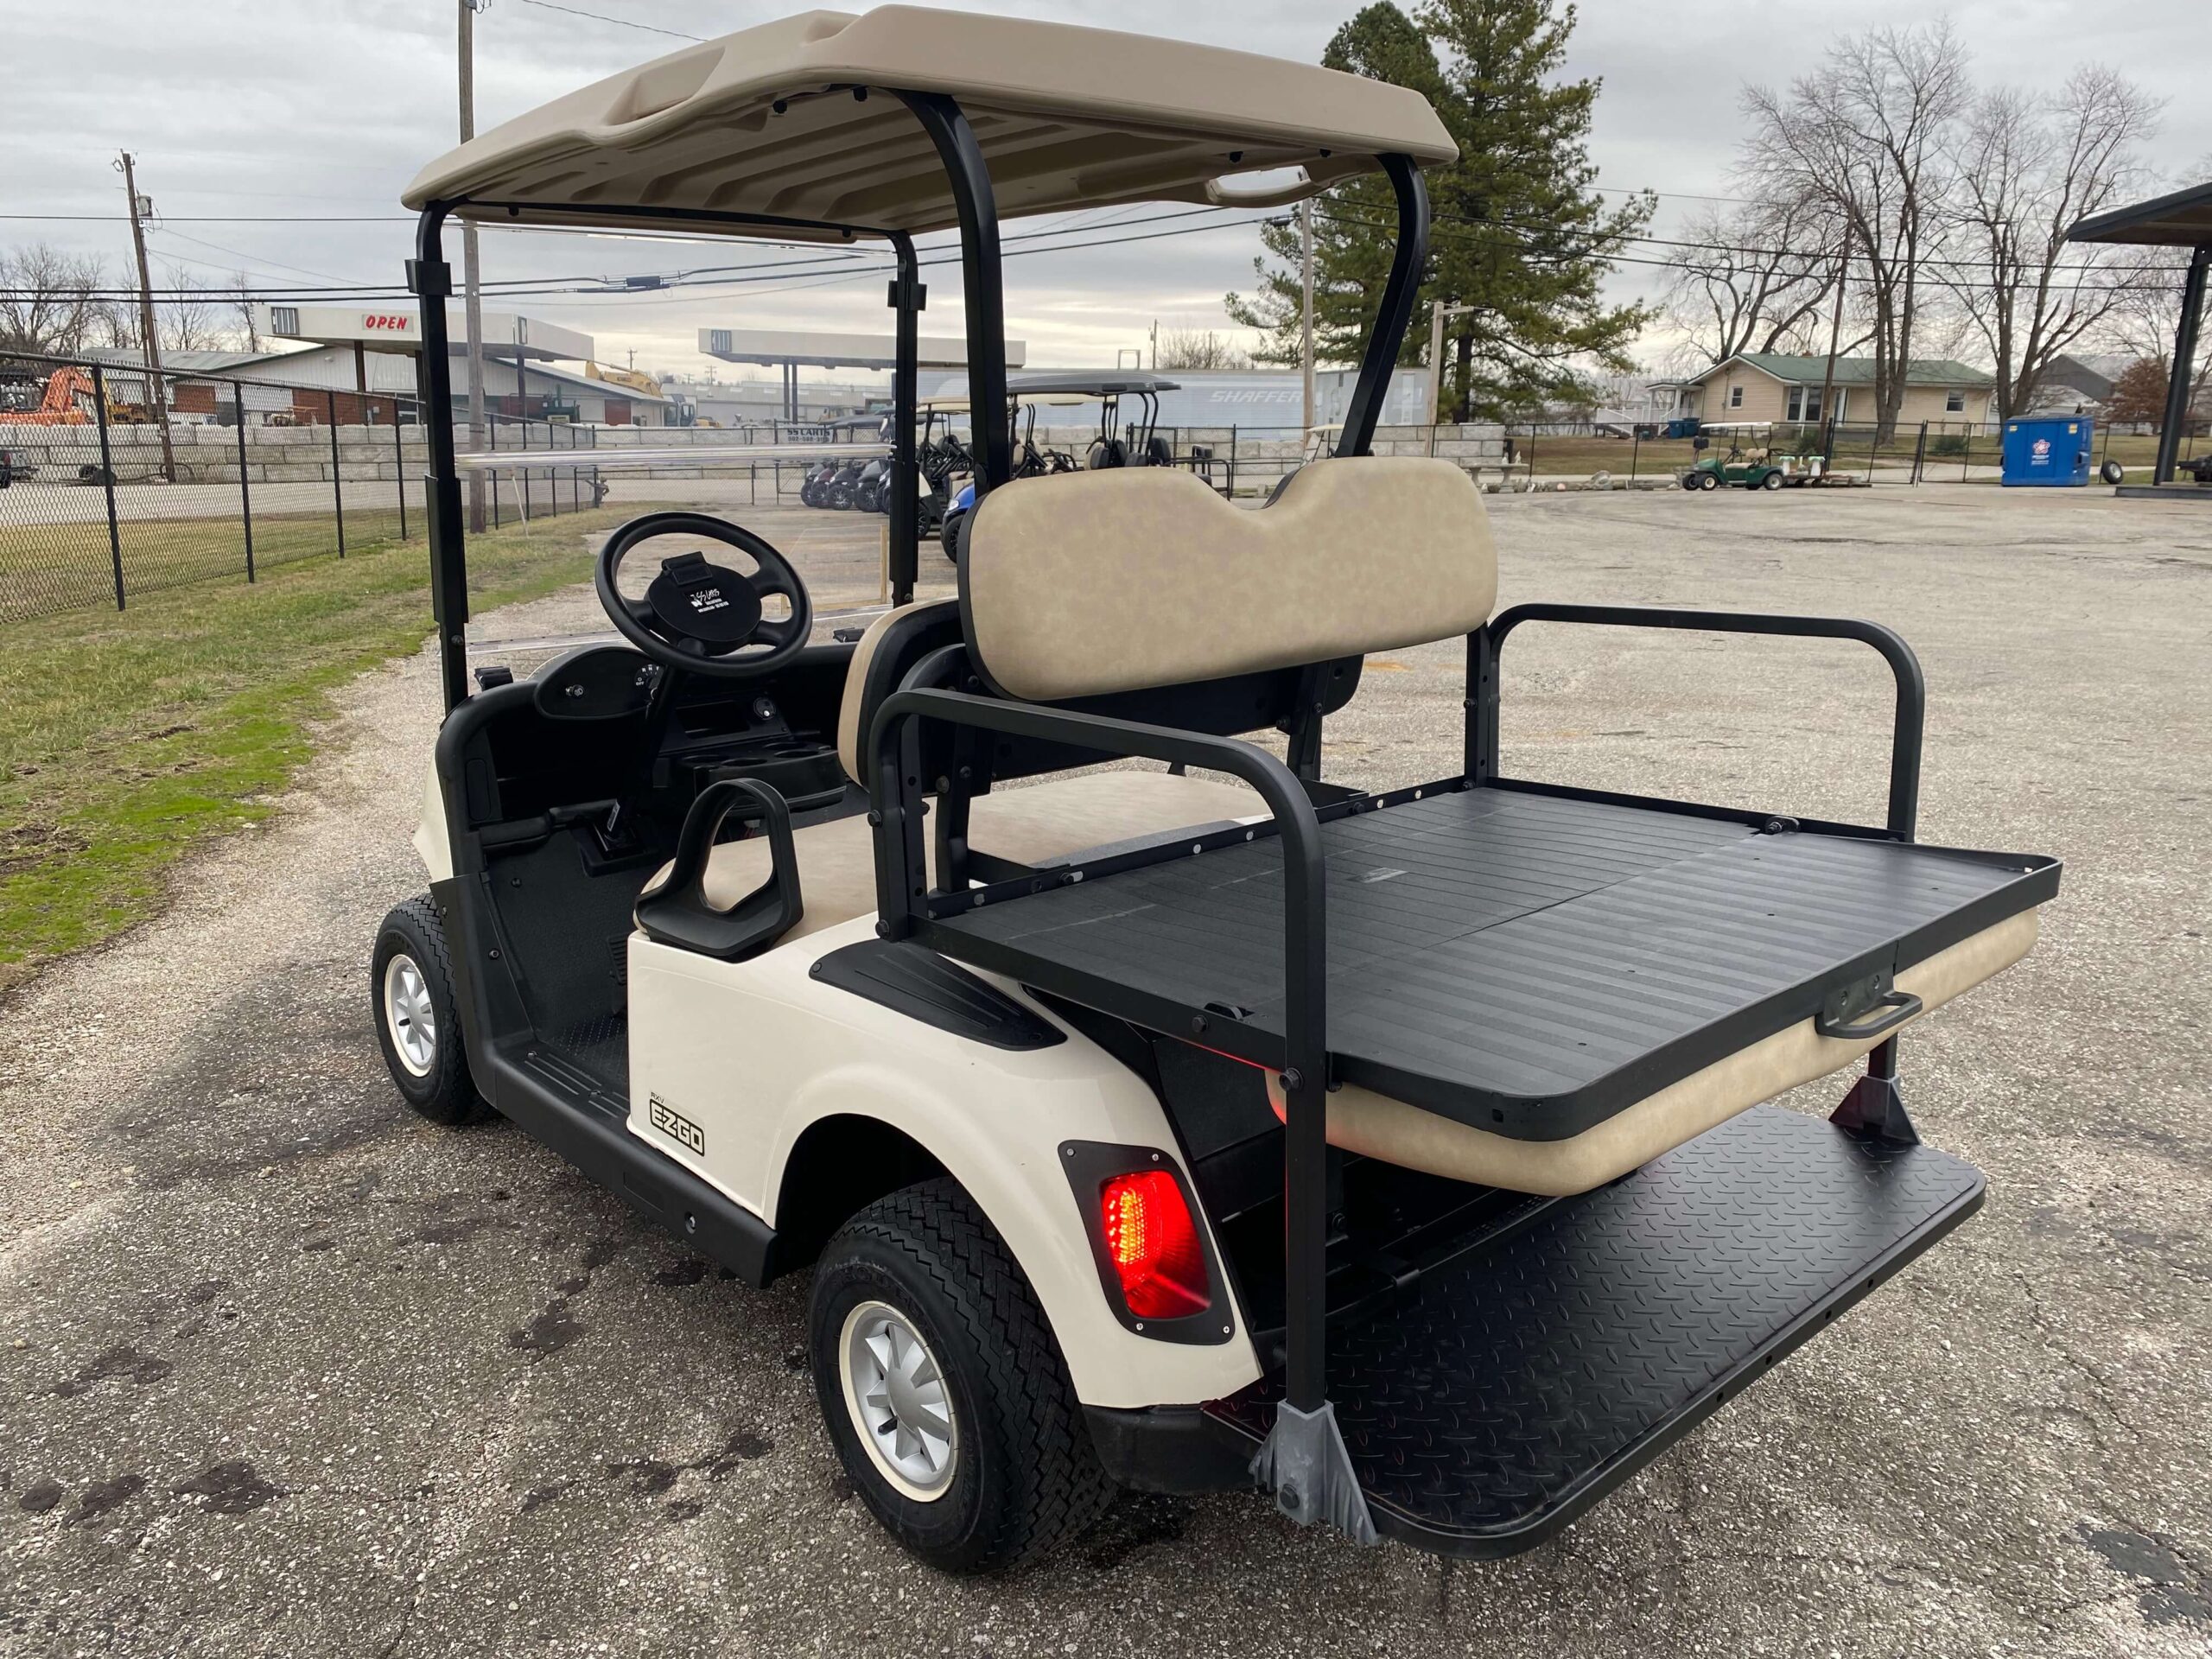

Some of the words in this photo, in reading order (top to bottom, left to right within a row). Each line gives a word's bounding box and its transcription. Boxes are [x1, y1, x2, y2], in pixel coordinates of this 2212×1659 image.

[365, 315, 408, 329] OPEN
[1210, 391, 1303, 403] SHAFFER
[651, 1091, 664, 1103] RXV
